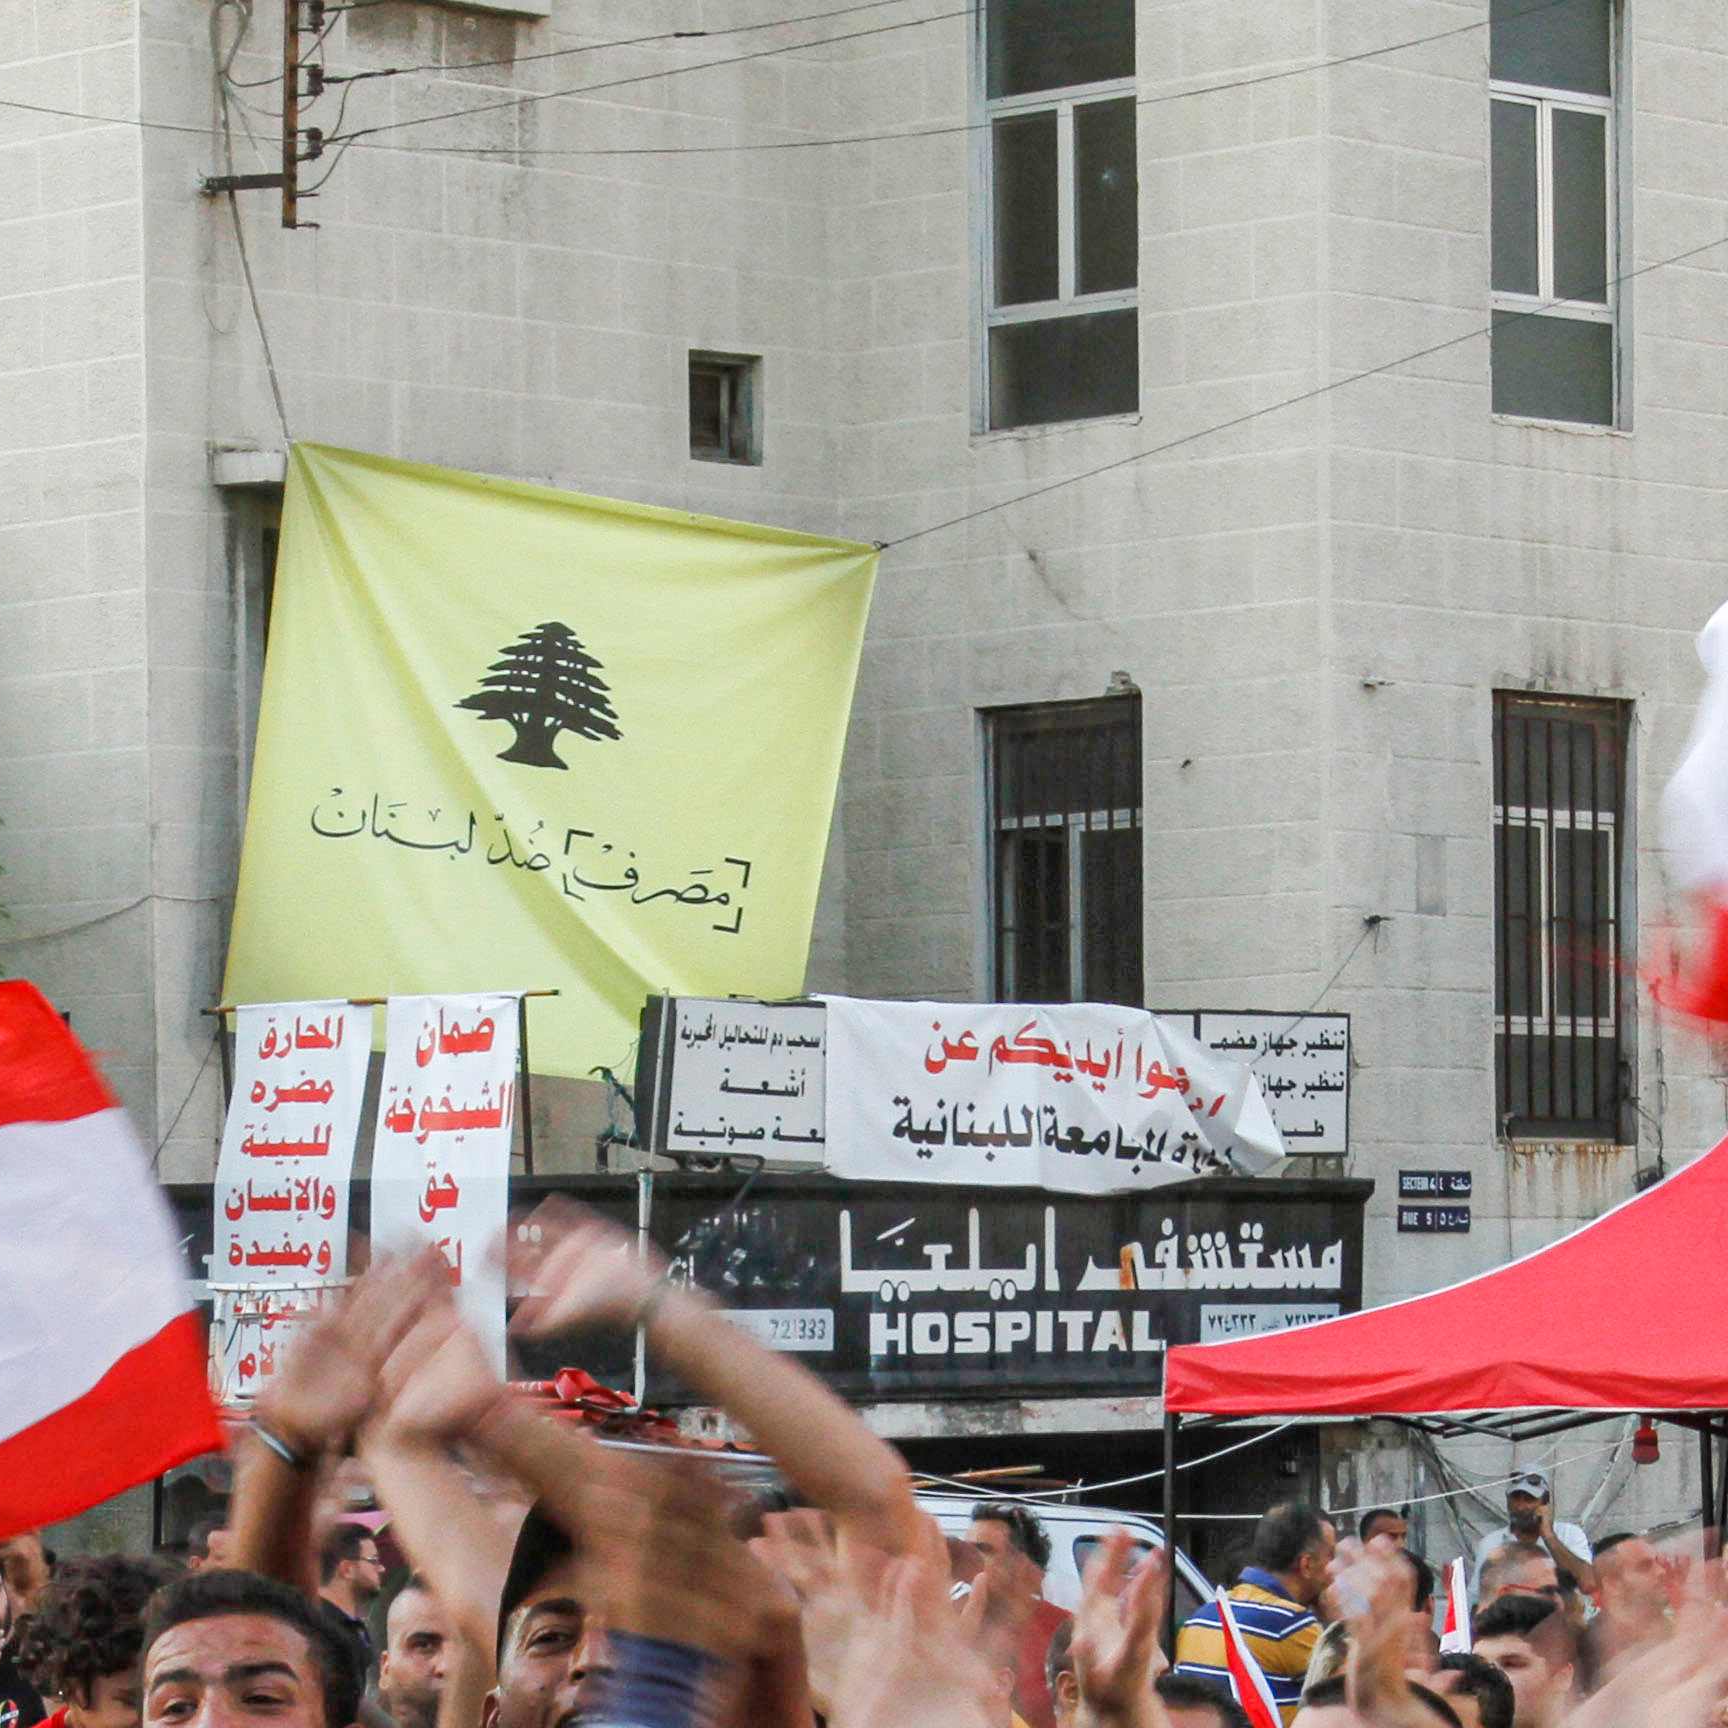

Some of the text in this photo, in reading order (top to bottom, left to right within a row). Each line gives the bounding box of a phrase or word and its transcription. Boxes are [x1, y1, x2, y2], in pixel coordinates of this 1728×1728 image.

[258, 1014, 345, 1060] المحارق
[415, 1005, 496, 1069] ضمان
[923, 1020, 980, 1075] عن
[987, 1020, 1125, 1094] أيديكم
[1209, 1029, 1258, 1051] هضم
[1261, 1031, 1299, 1058] جهاز
[384, 1080, 513, 1145] الشيخوخة
[891, 1095, 1043, 1162] اللبنانية
[239, 1122, 333, 1166] للبيئة
[224, 1176, 337, 1223] والإنسان
[418, 1160, 460, 1224] حق
[227, 1231, 333, 1275] ومفيدة
[1075, 1216, 1343, 1291] مستشفى
[869, 1310, 1165, 1355] HOSPITAL
